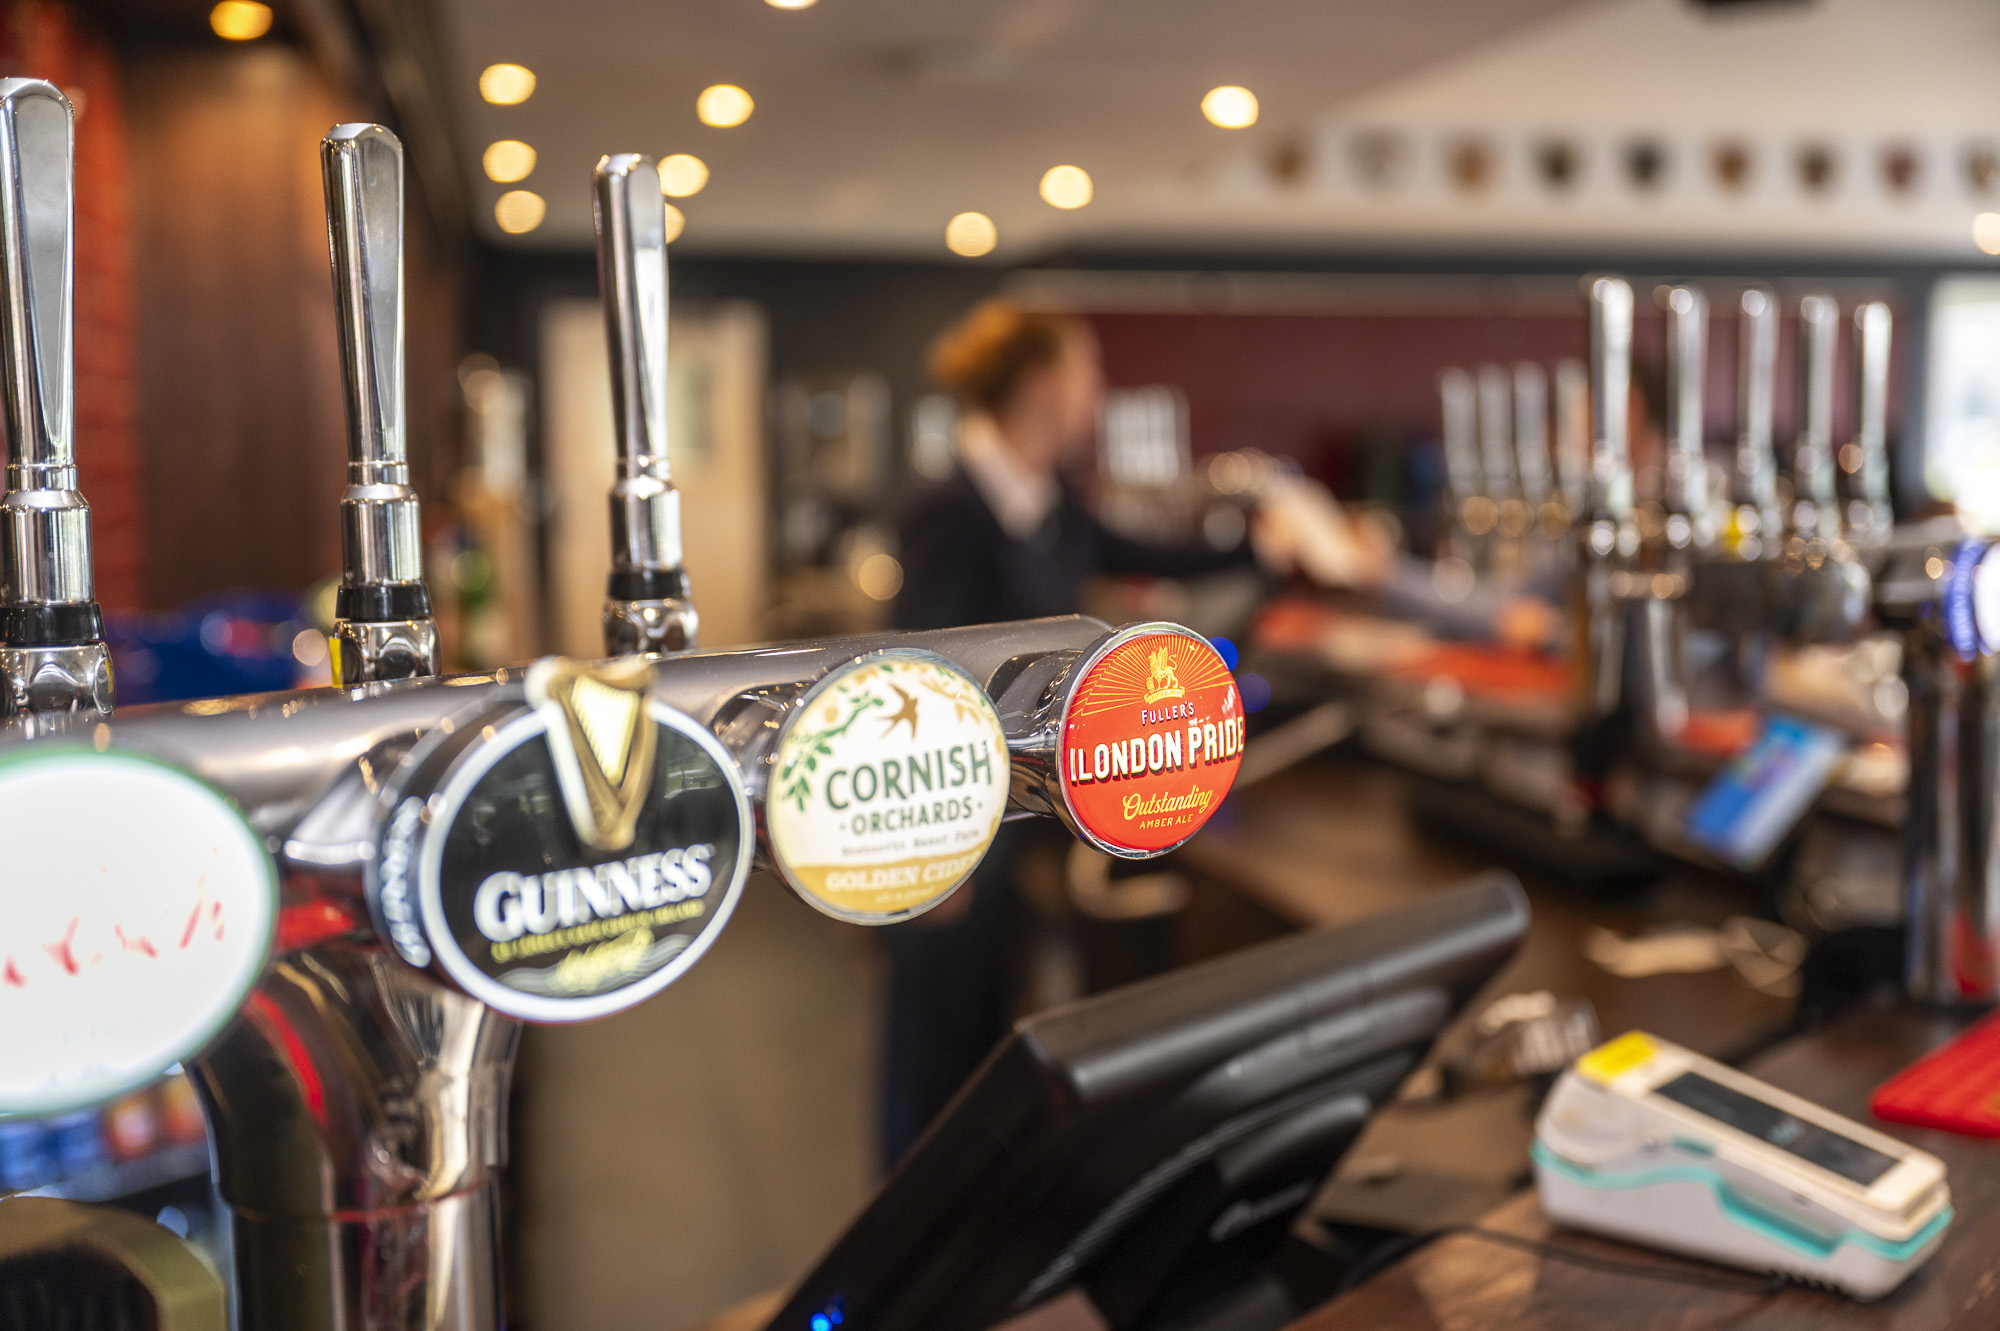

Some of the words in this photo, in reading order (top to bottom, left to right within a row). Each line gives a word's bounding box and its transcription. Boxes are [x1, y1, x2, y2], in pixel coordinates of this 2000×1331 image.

[1141, 701, 1195, 726] FULLER'S
[1077, 730, 1184, 784] LONDON
[1187, 716, 1244, 769] PRIDE
[825, 741, 993, 811] CORNISH
[851, 797, 973, 836] ORCHARDS
[1122, 784, 1214, 821] Outstanding
[1139, 817, 1174, 830] AMBER
[1175, 813, 1194, 824] ALE
[473, 843, 714, 943] GUINNESS
[825, 865, 920, 893] GOLDEN
